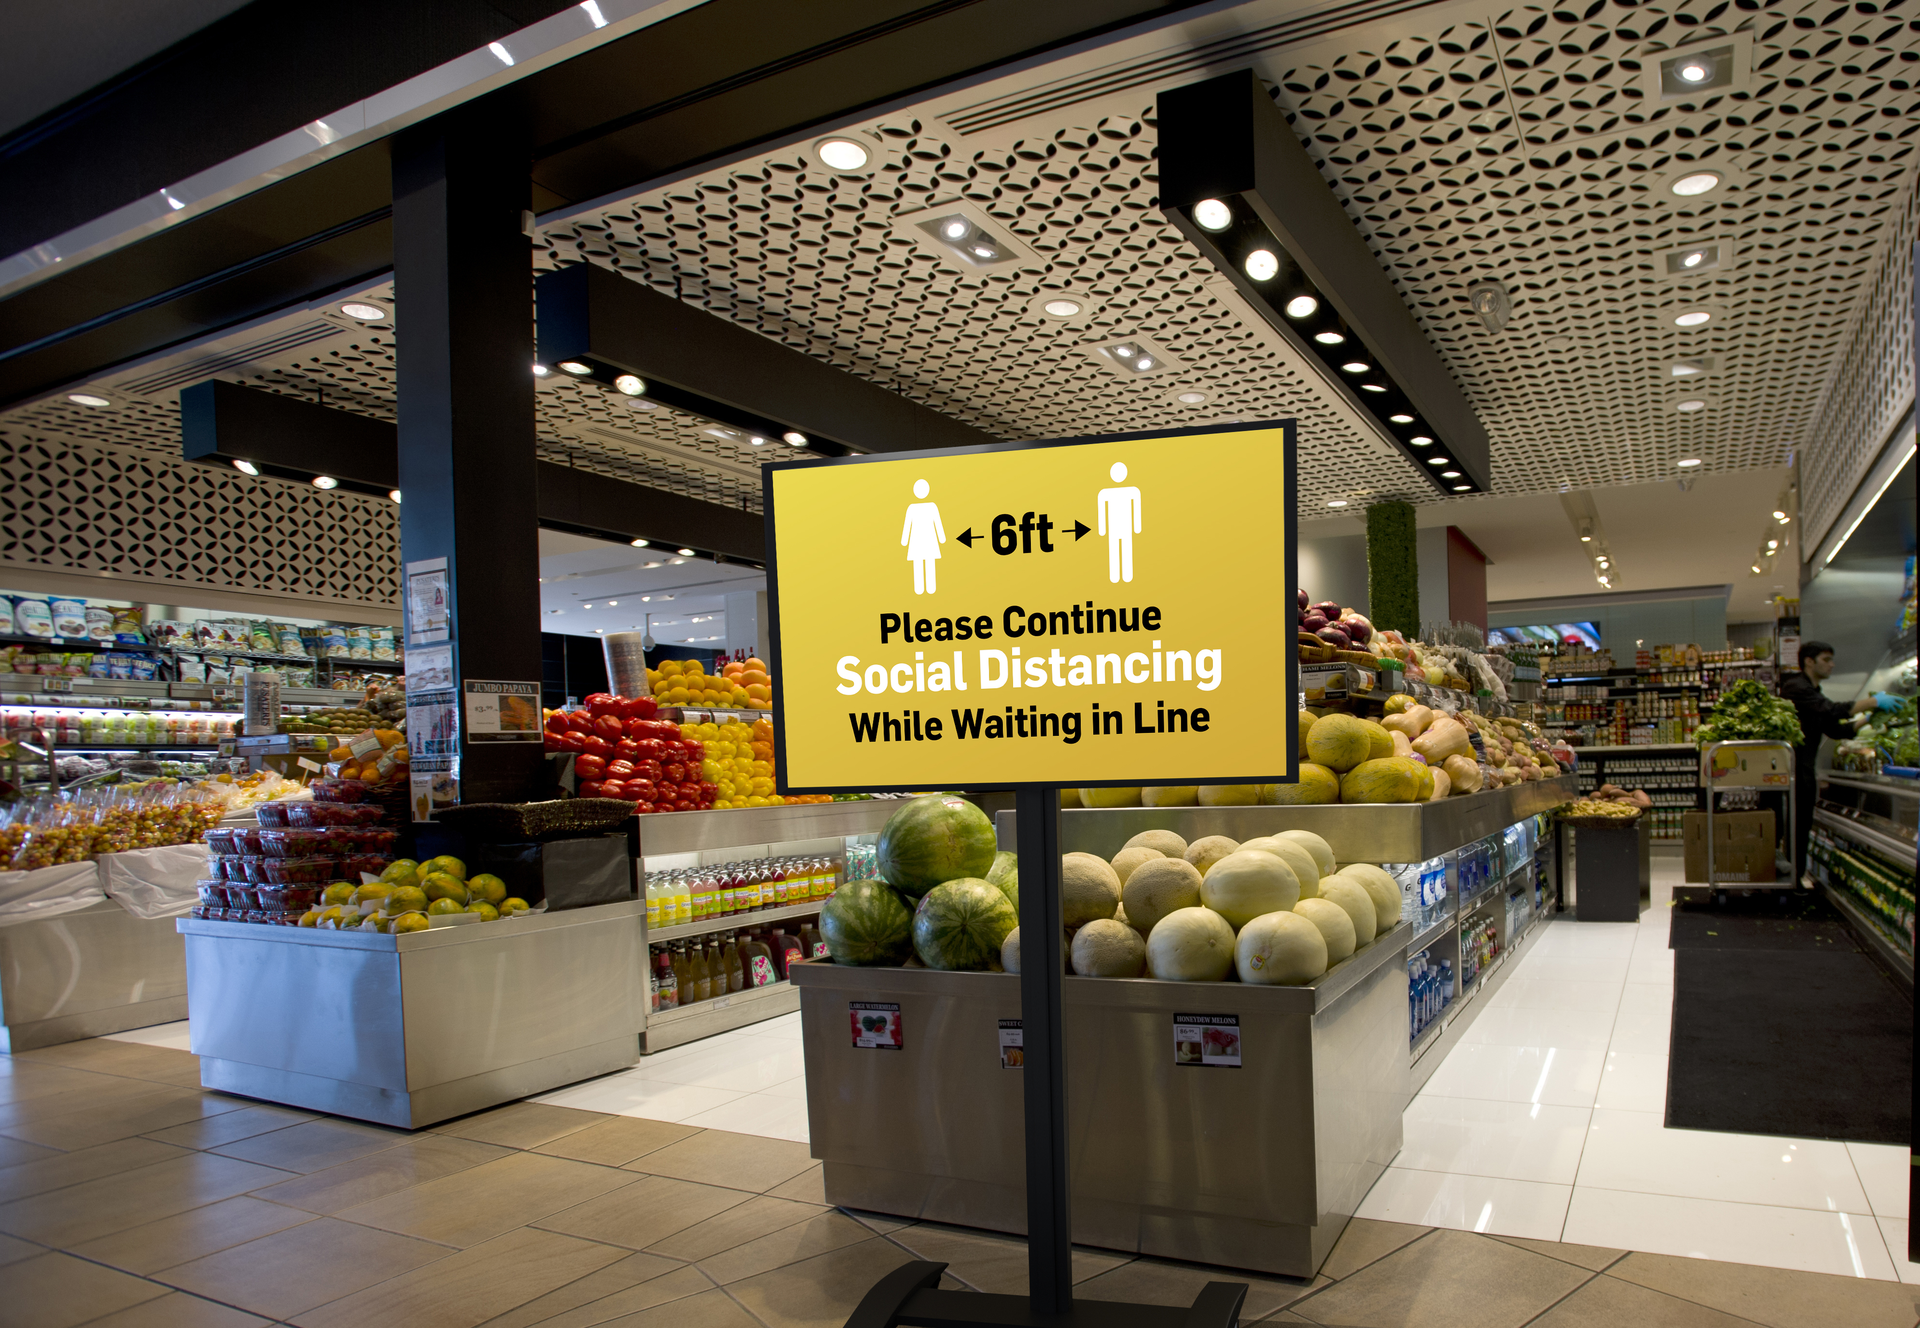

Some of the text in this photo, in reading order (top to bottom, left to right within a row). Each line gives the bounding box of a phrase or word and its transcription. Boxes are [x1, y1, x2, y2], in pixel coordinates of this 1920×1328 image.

[991, 512, 1054, 556] 6ft
[879, 600, 1162, 645] Please Continue
[473, 682, 533, 694] JUMBO PAPAYA
[835, 639, 1222, 696] Social Distancing
[1320, 663, 1346, 671] MELONS
[848, 700, 1211, 745] While Waiting in Line
[1176, 1015, 1237, 1025] HONEYDEW MELONS
